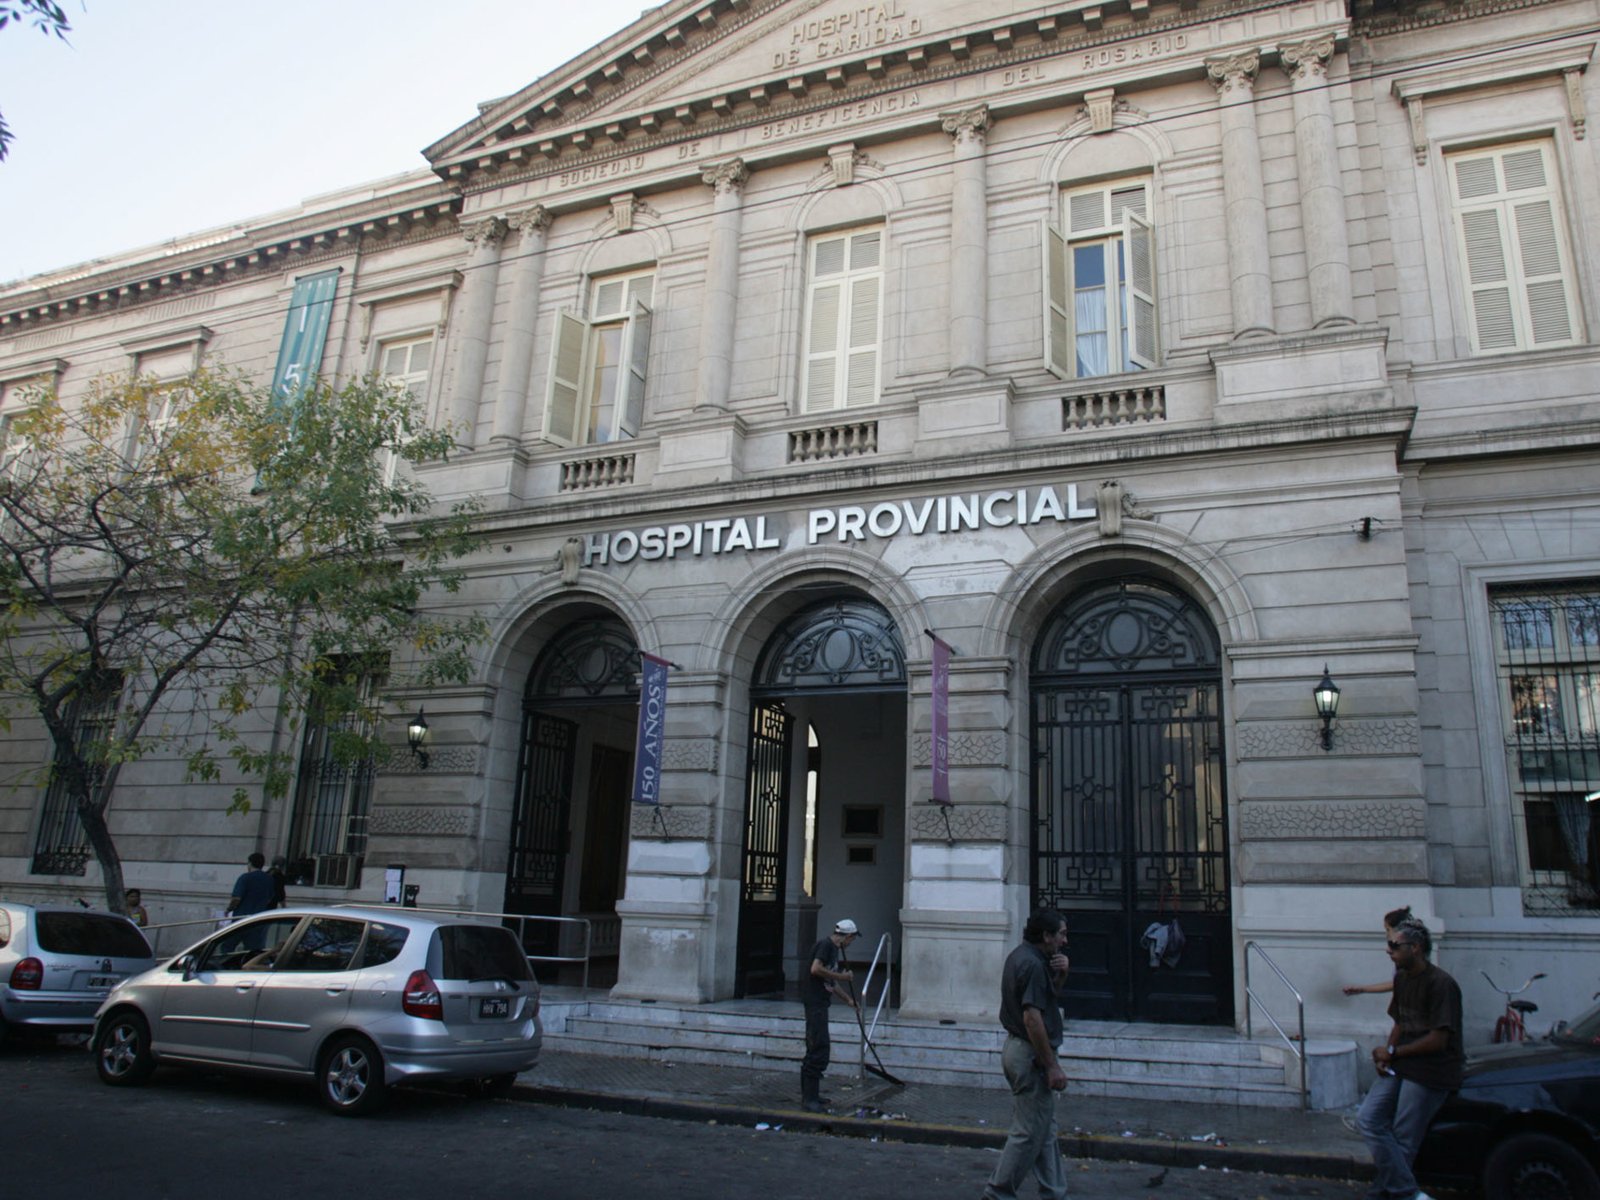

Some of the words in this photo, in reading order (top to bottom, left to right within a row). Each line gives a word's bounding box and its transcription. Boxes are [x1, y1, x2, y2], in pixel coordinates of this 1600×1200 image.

[772, 49, 800, 69] DE
[816, 17, 922, 58] CARIDAD
[790, 0, 906, 45] HOSPITAL
[559, 156, 645, 187] SOCIEDAD
[678, 143, 701, 160] DE
[761, 91, 921, 140] BENEFICENCIA
[1003, 66, 1046, 87] DEL
[1081, 34, 1189, 70] ROSARIO
[582, 516, 780, 567] HOSPITAL
[808, 483, 1098, 545] PROVINCIAL
[643, 684, 662, 759] AÑOS
[641, 766, 655, 801] 150
